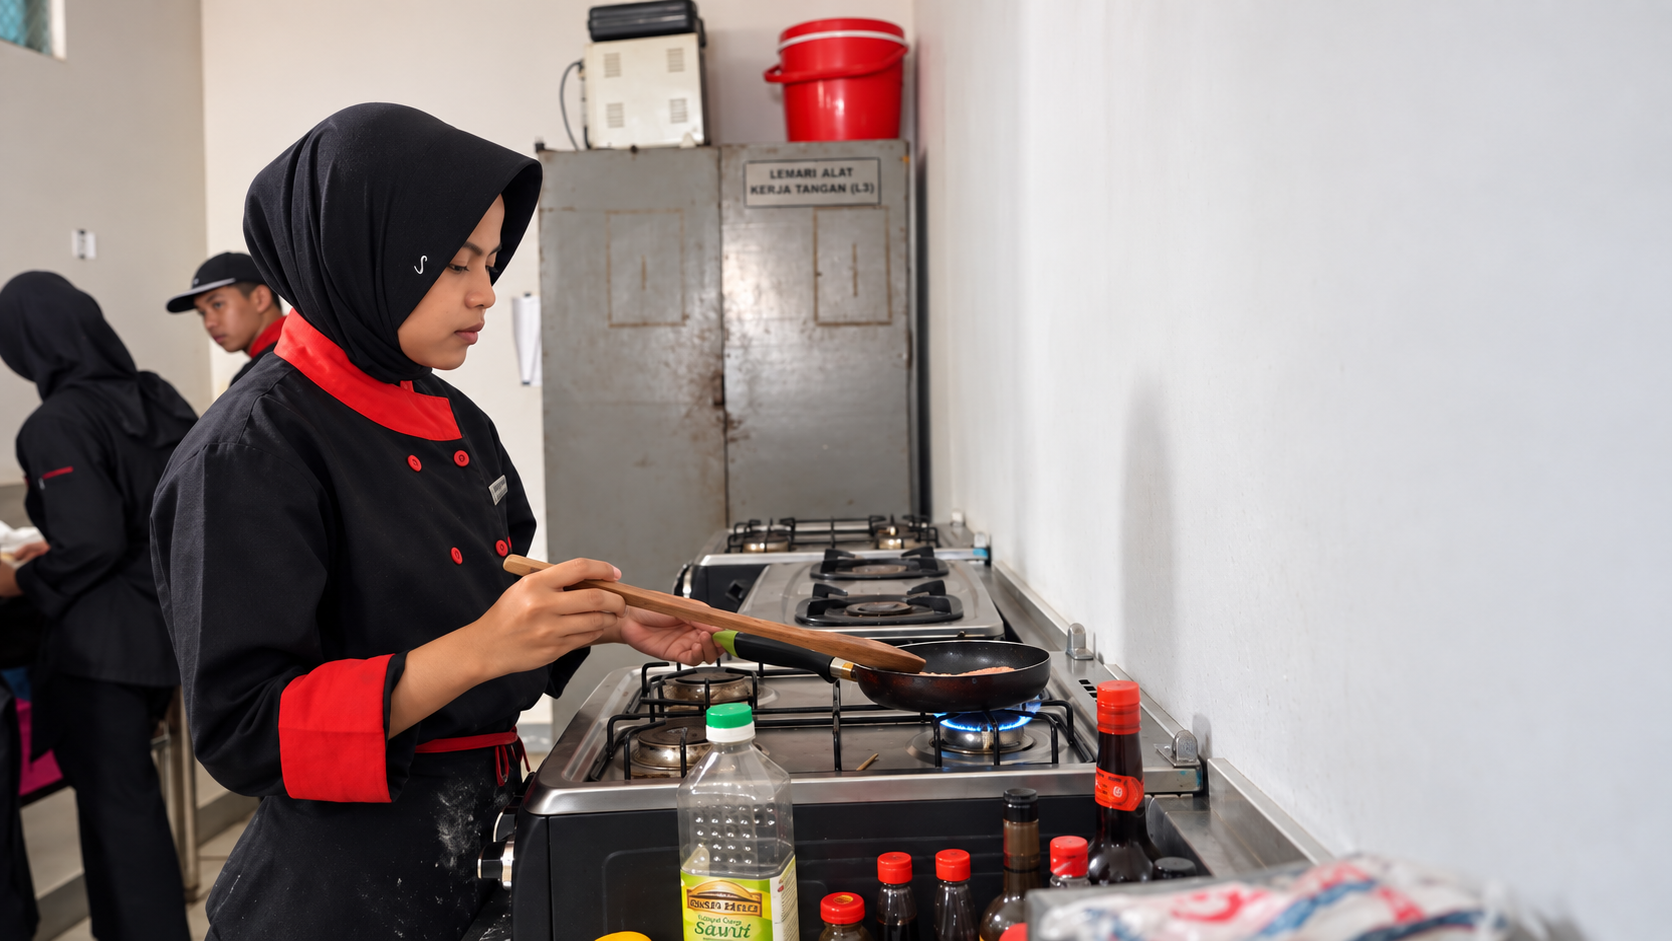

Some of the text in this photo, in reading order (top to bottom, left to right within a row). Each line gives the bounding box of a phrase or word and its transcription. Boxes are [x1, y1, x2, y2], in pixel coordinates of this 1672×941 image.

[769, 167, 854, 180] LEMARI ALAT
[750, 182, 875, 195] KERJA TANGAN (L3)
